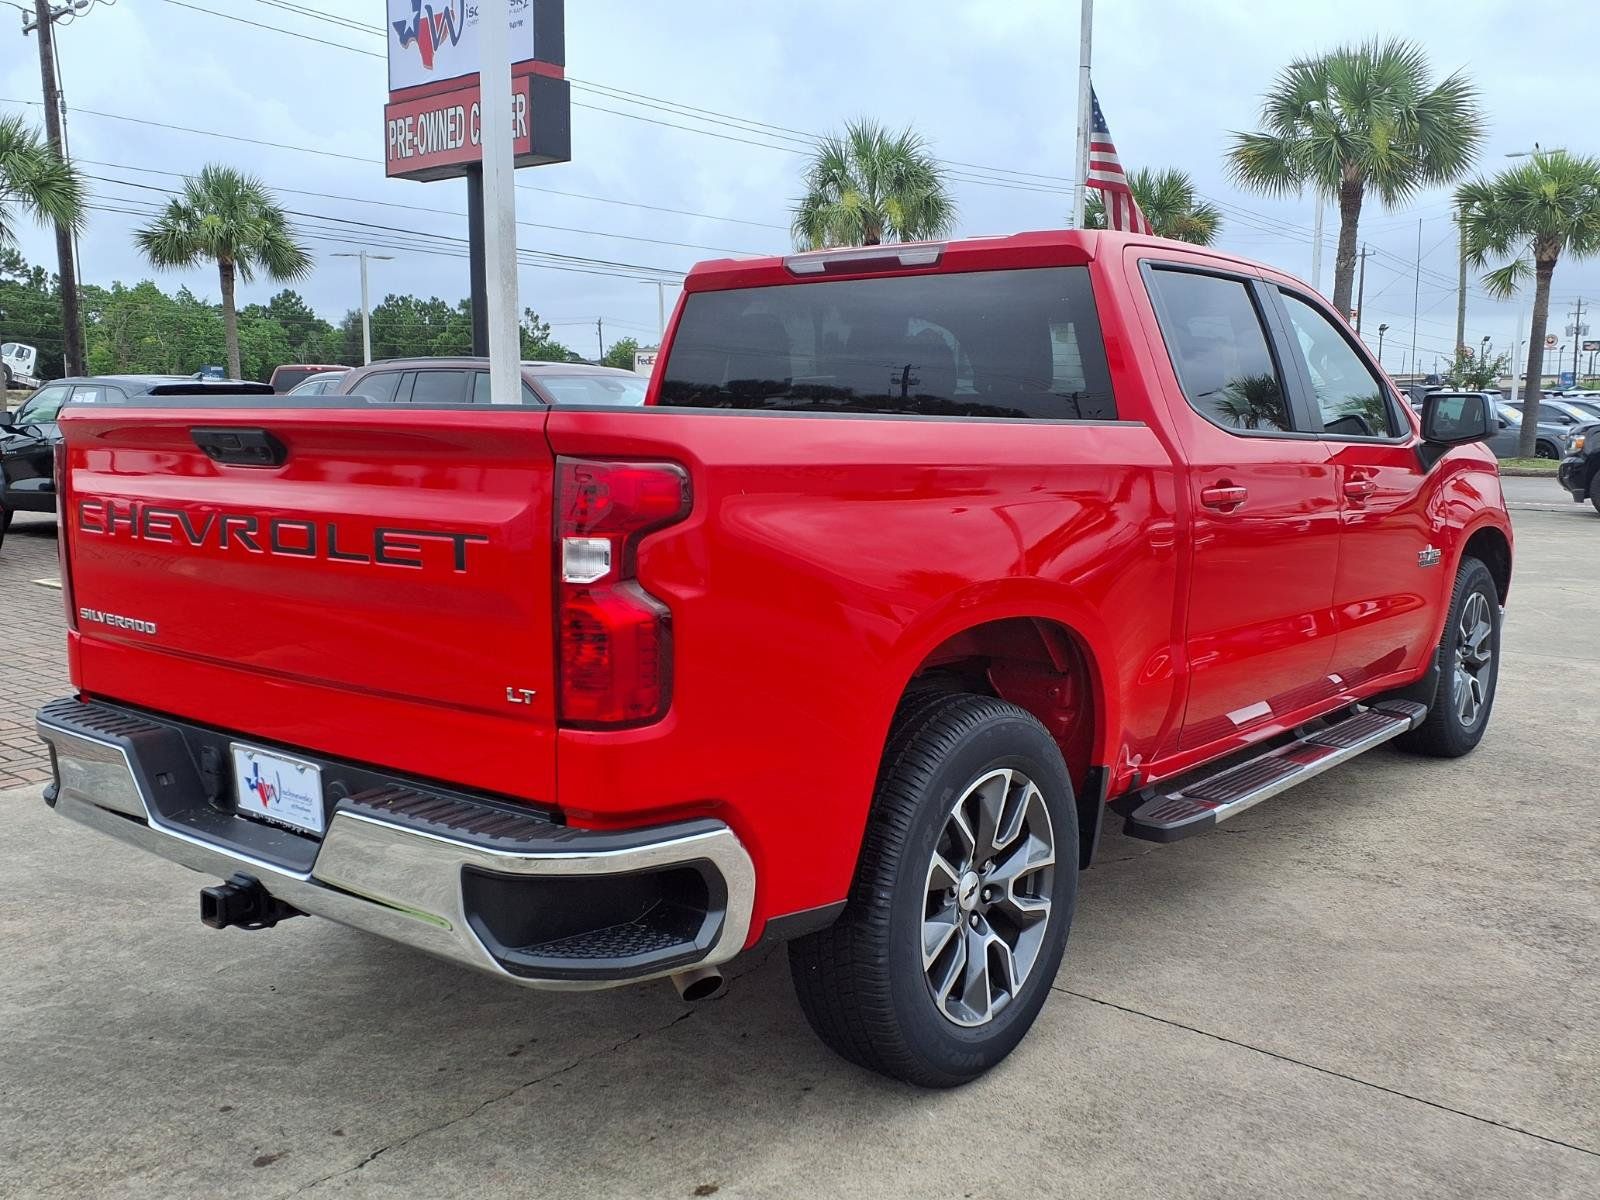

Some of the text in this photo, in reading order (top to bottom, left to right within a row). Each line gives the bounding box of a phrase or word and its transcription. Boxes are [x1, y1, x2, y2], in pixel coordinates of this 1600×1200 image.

[388, 105, 466, 161] PRE-OWNED
[79, 500, 489, 573] CHEVROLET
[80, 607, 157, 634] SILVERADO
[506, 686, 536, 705] LT
